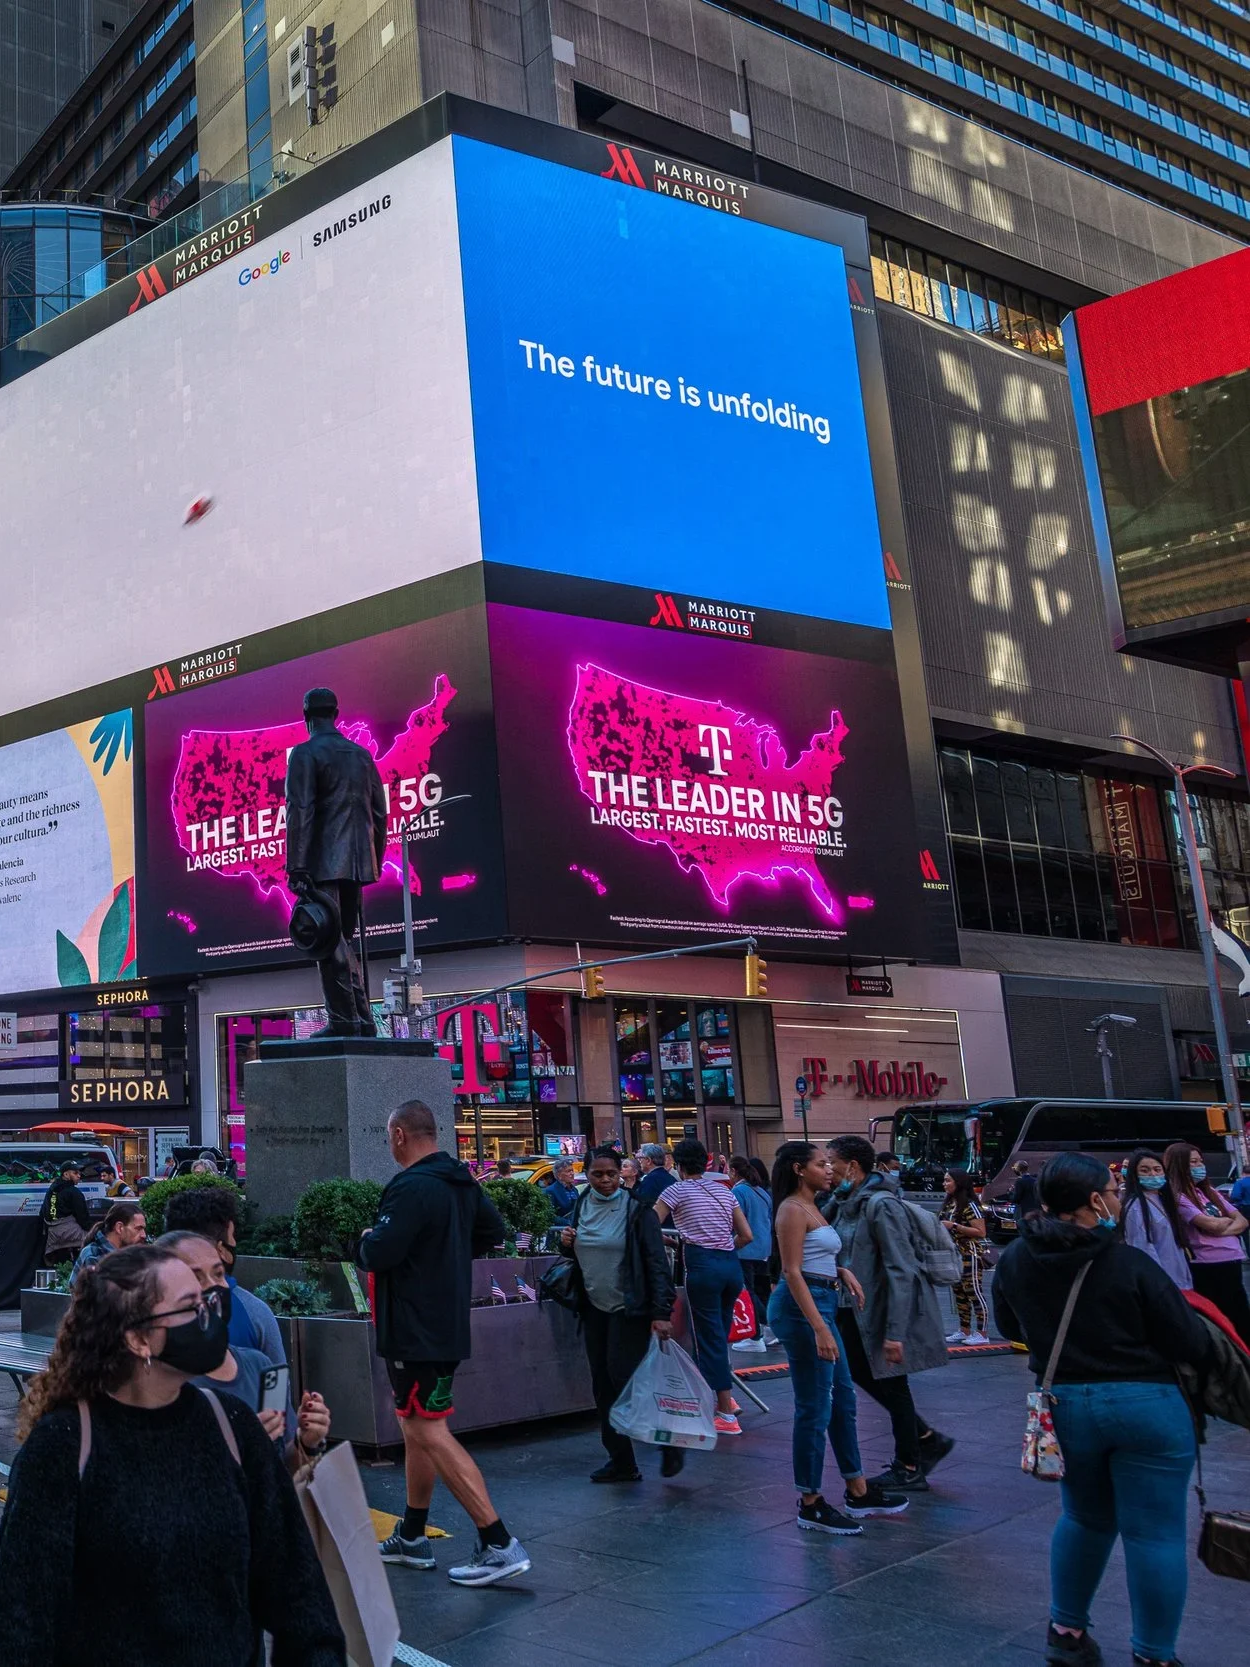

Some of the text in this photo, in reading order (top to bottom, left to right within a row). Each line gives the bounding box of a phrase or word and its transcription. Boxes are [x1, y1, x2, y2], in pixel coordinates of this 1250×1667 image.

[655, 160, 749, 199] MARRIOTT
[657, 179, 741, 215] MARQUIS
[313, 194, 391, 247] SAMSUNG
[175, 205, 263, 265] MARRIOTT
[176, 231, 253, 284] MARQUIS
[238, 250, 291, 286] Google
[519, 339, 831, 444] The future is unfolding
[689, 601, 756, 622] MARRIOTT
[690, 616, 750, 636] MARQUIS
[181, 644, 242, 671] MARRIOTT
[181, 660, 236, 686] MARQUIS
[19, 790, 49, 805] means
[399, 773, 442, 811] 5G
[587, 770, 843, 828] THE LEADER IN 5G
[6, 812, 24, 826] and
[25, 808, 40, 822] the
[41, 800, 81, 817] richness
[186, 809, 287, 853] THE LEA
[412, 829, 440, 840] UMLAUT
[590, 807, 847, 848] LARGEST. FASTEST. MOST RELIABLE.
[186, 847, 248, 872] LARGEST.
[781, 845, 813, 854] ACCORDING
[4, 872, 37, 887] Research
[923, 882, 949, 891] ARRIOTT
[97, 990, 149, 1006] SEPHORA
[70, 1080, 170, 1104] SEPHORA
